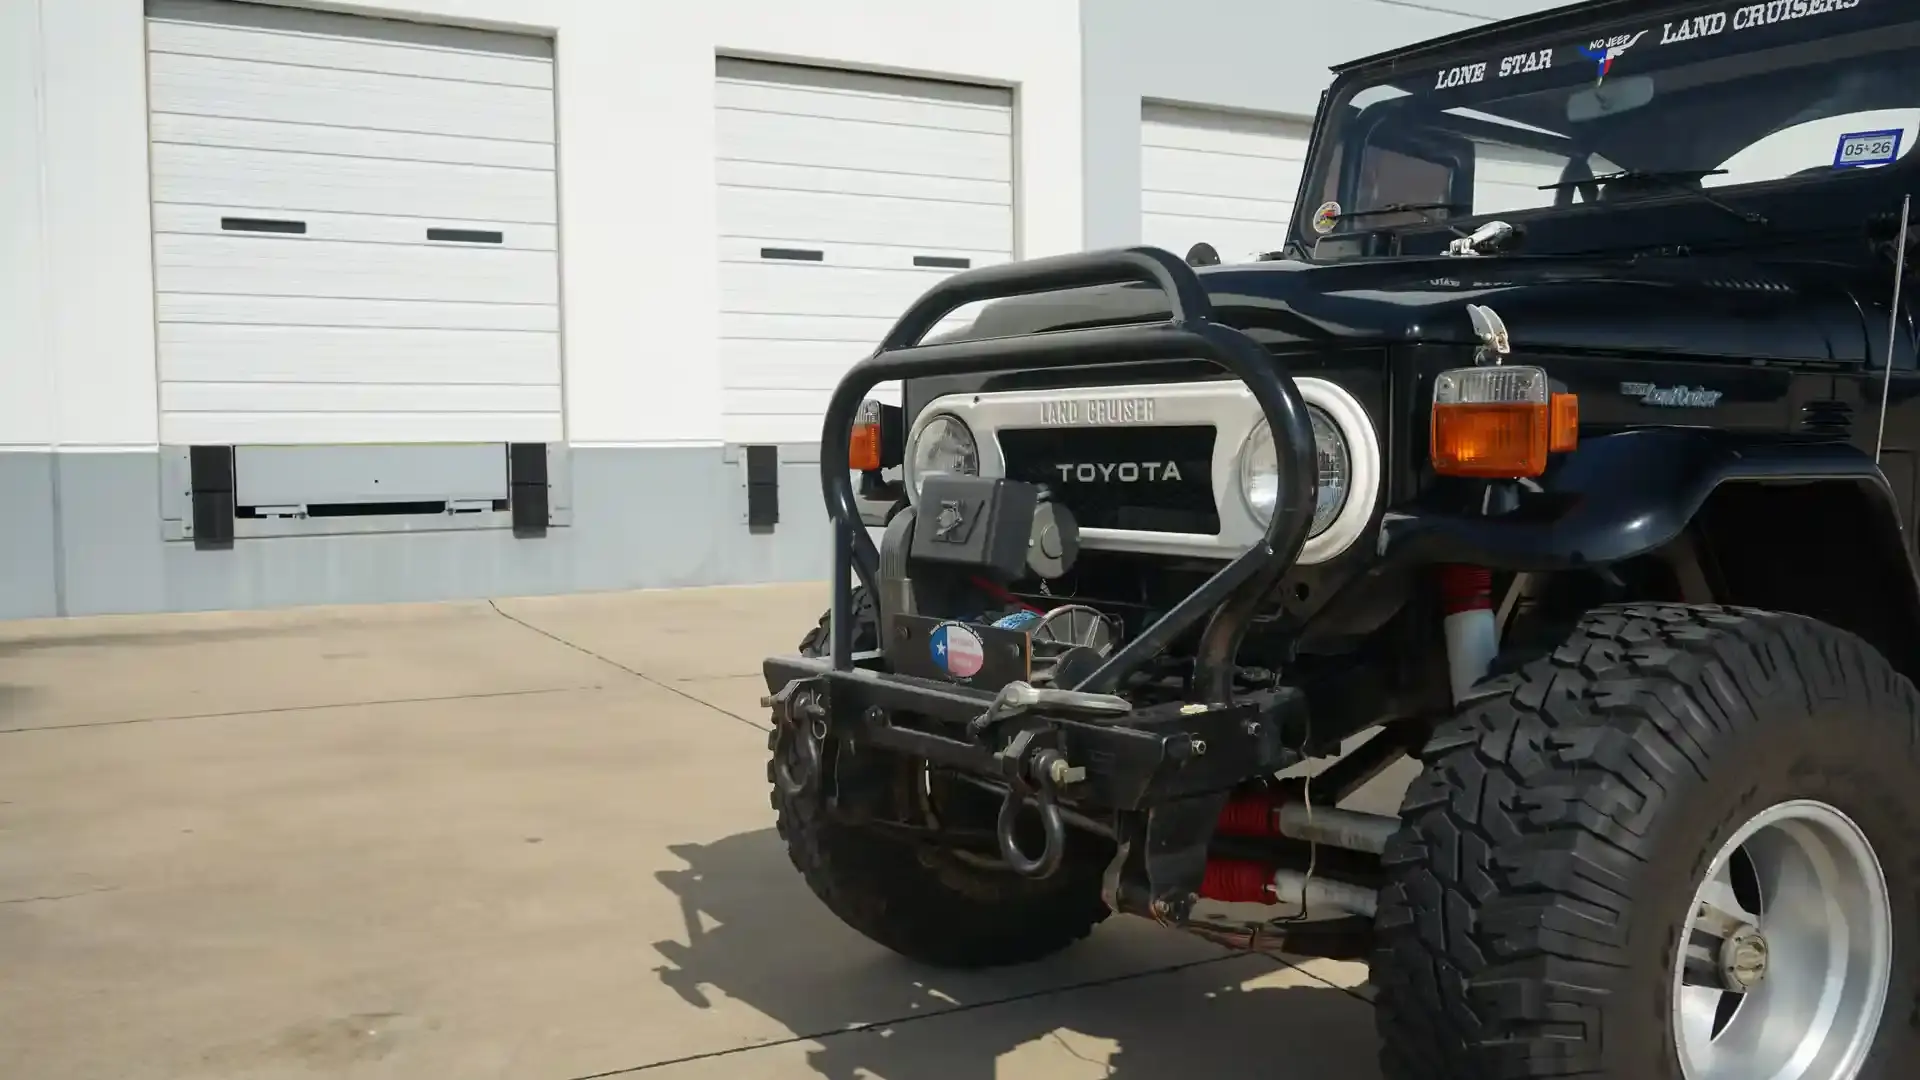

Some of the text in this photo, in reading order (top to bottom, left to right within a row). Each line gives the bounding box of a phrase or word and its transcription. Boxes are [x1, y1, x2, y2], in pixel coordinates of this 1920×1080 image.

[1660, 11, 1726, 45] LAND
[1589, 34, 1630, 50] NO JEEP
[1434, 48, 1552, 90] LONE STAR
[1040, 398, 1156, 425] LAND CRUISER
[1055, 460, 1182, 482] TOYOTA
